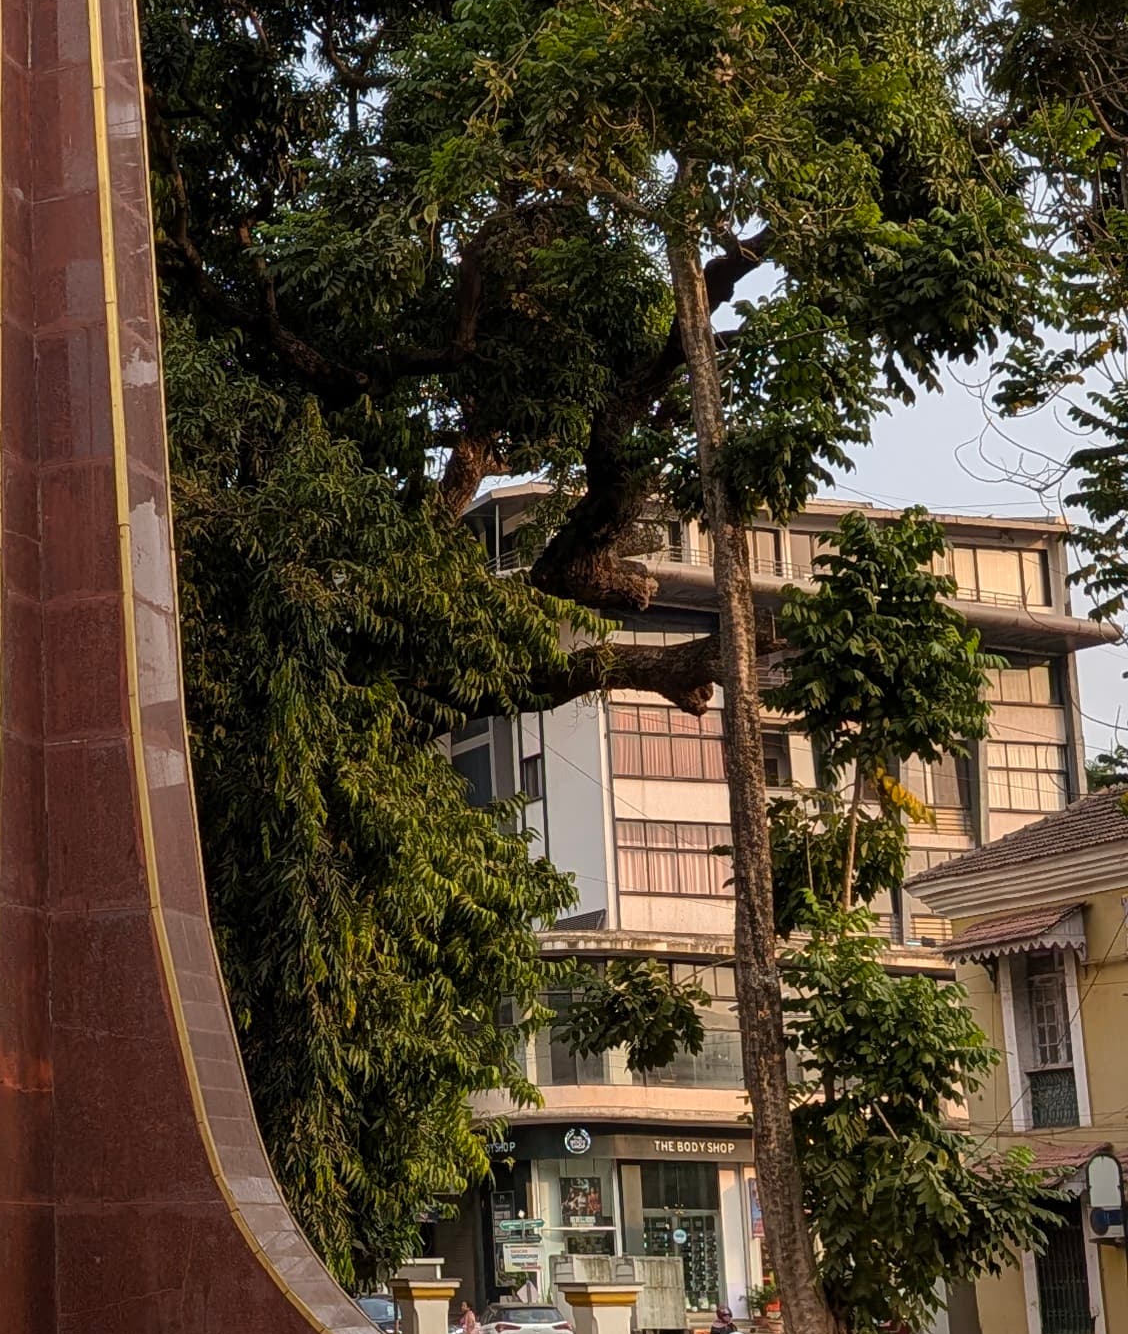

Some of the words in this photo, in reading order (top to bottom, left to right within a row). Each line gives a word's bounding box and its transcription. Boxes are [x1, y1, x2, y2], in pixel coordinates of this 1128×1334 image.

[654, 1140, 674, 1152] THE
[677, 1141, 706, 1153] BODY
[707, 1142, 735, 1154] SHOP
